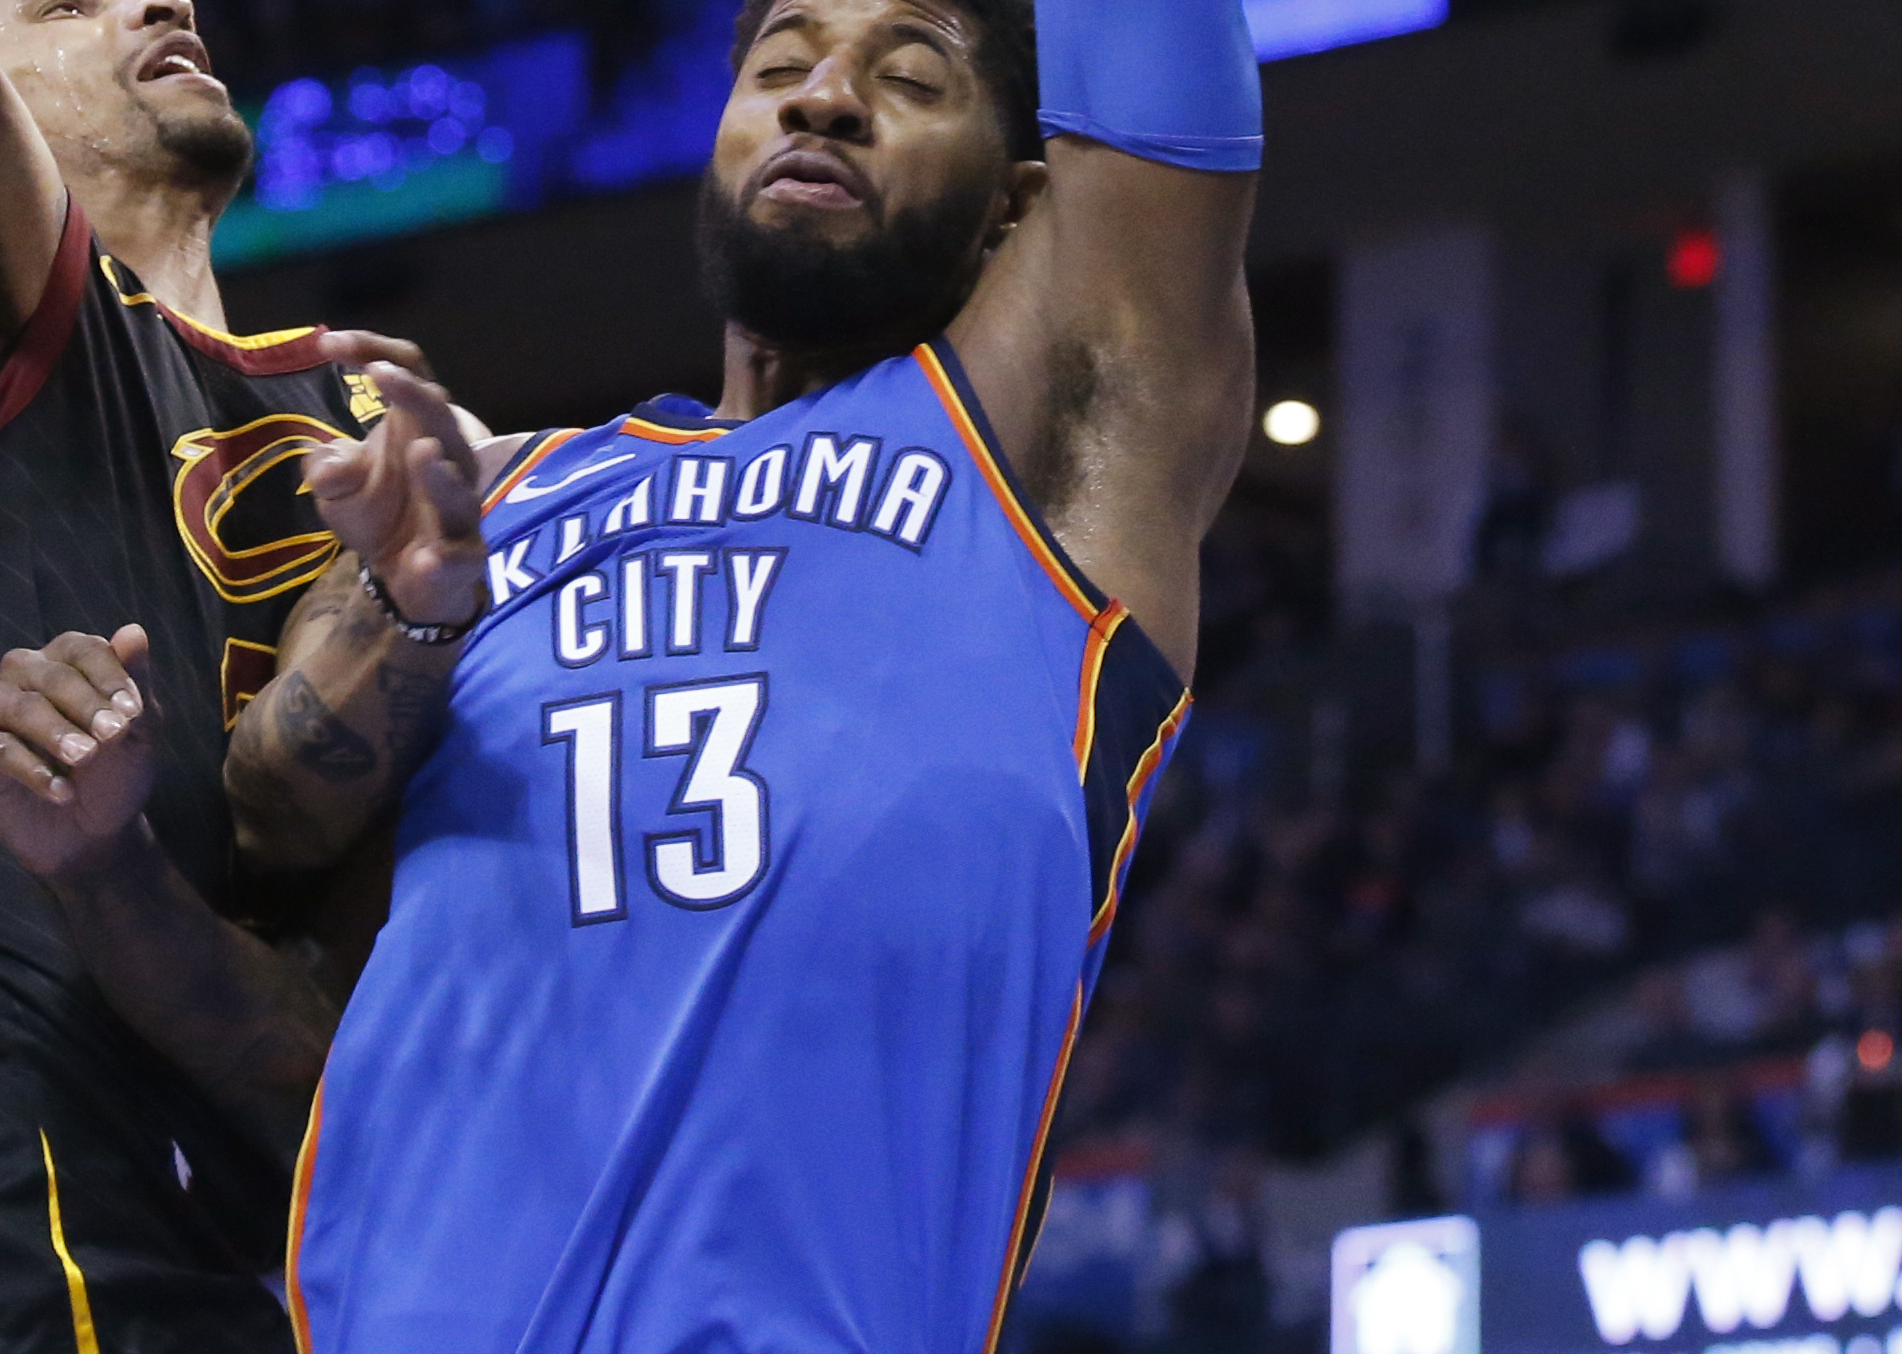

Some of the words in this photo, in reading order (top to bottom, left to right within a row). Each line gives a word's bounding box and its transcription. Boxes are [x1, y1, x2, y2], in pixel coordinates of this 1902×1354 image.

[483, 431, 952, 610] KLAHOMA
[552, 546, 789, 669] CITY
[541, 672, 772, 928] 13
[1579, 1205, 1902, 1345] WWW
